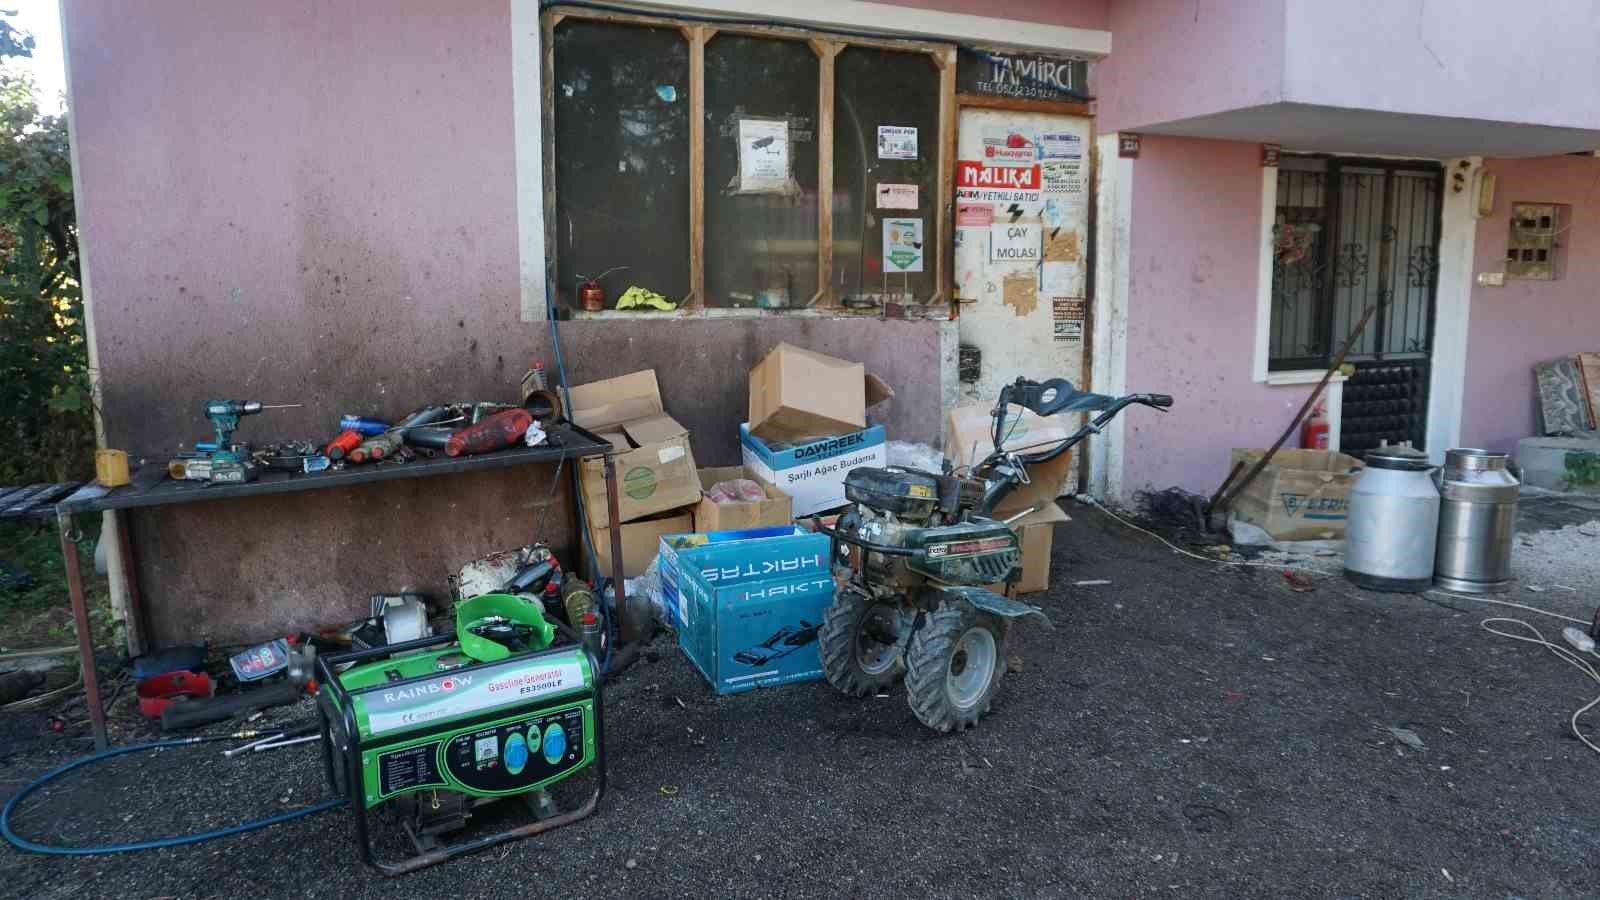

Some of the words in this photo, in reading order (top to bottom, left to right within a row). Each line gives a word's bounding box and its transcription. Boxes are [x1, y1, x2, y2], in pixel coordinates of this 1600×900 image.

[964, 166, 1033, 188] MALIKA
[1007, 228, 1029, 241] ÇAY
[997, 248, 1038, 259] MOLASI
[794, 433, 866, 460] DAWREEK
[840, 452, 878, 472] Budama
[745, 579, 832, 602] HAKT
[383, 674, 474, 704] RAINBOW
